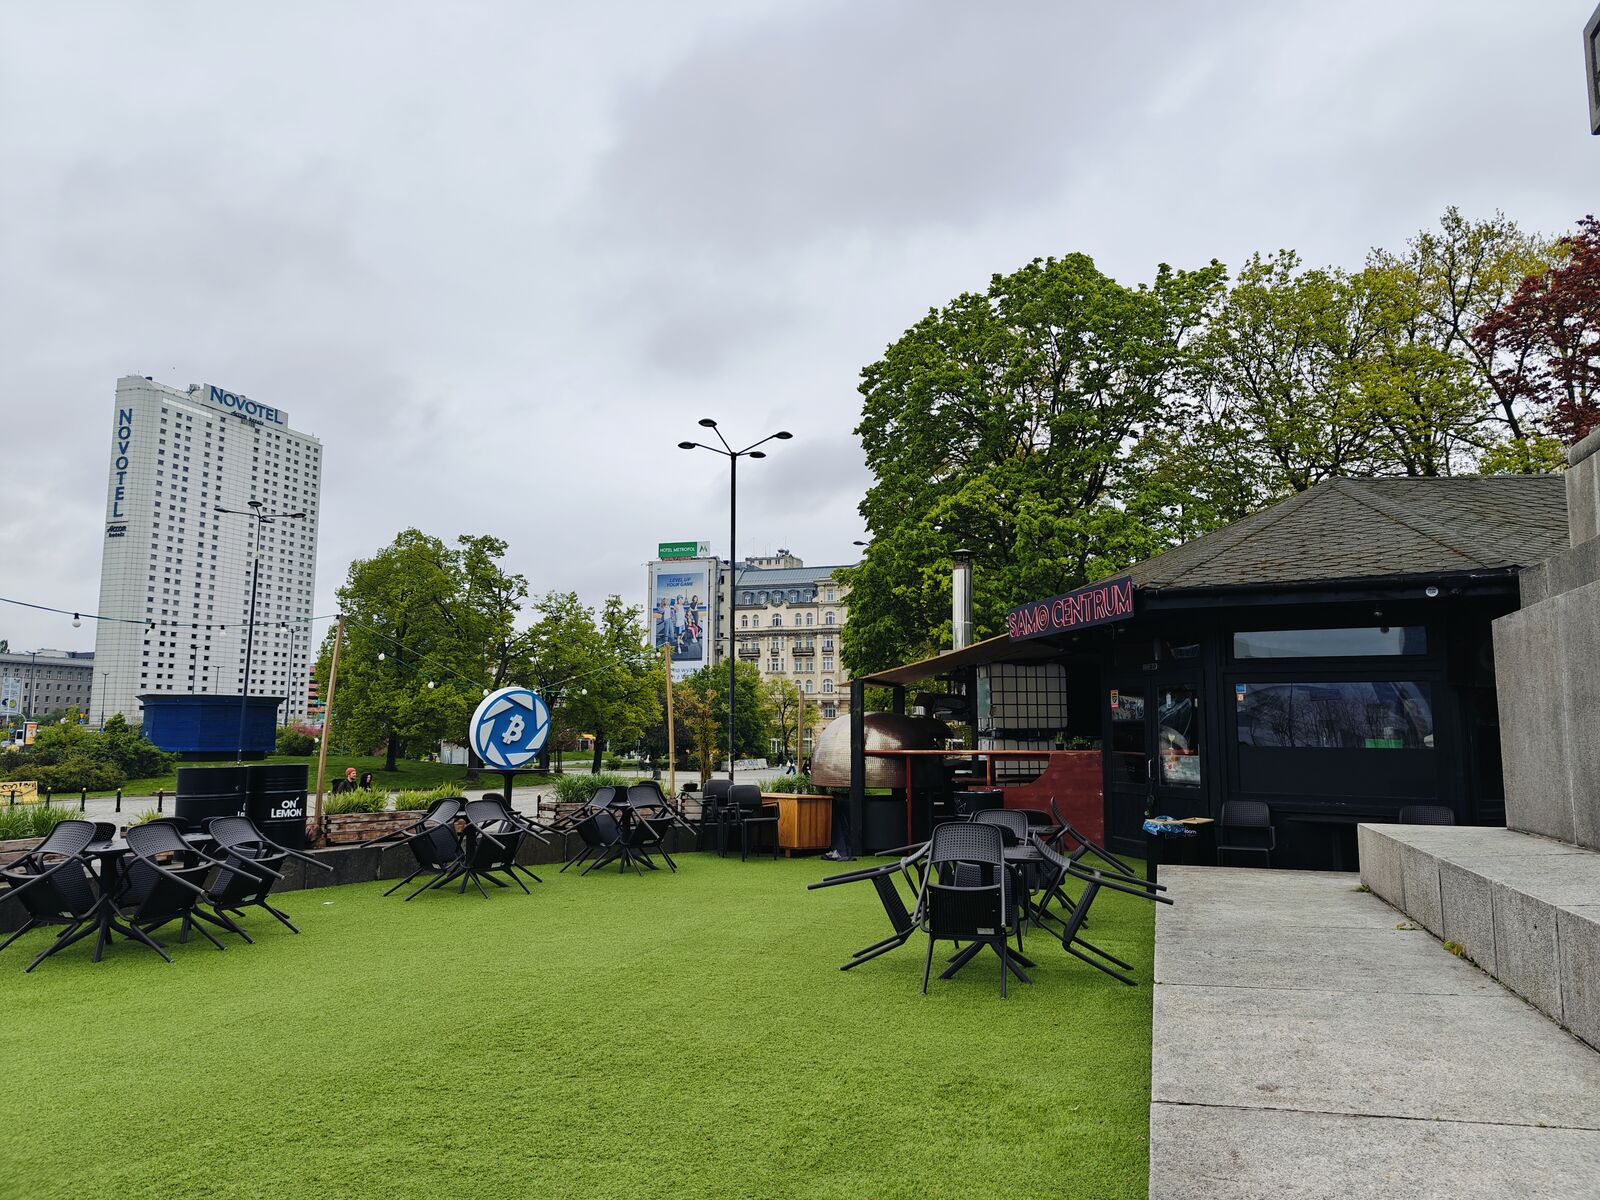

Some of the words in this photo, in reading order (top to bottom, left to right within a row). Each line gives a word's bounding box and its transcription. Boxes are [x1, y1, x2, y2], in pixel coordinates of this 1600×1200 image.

[210, 385, 283, 425] NOVOTEL
[113, 408, 132, 517] NOVOTEL
[1008, 604, 1049, 638] SAMO
[1051, 580, 1133, 628] CENTRUM
[271, 808, 302, 818] LEMON
